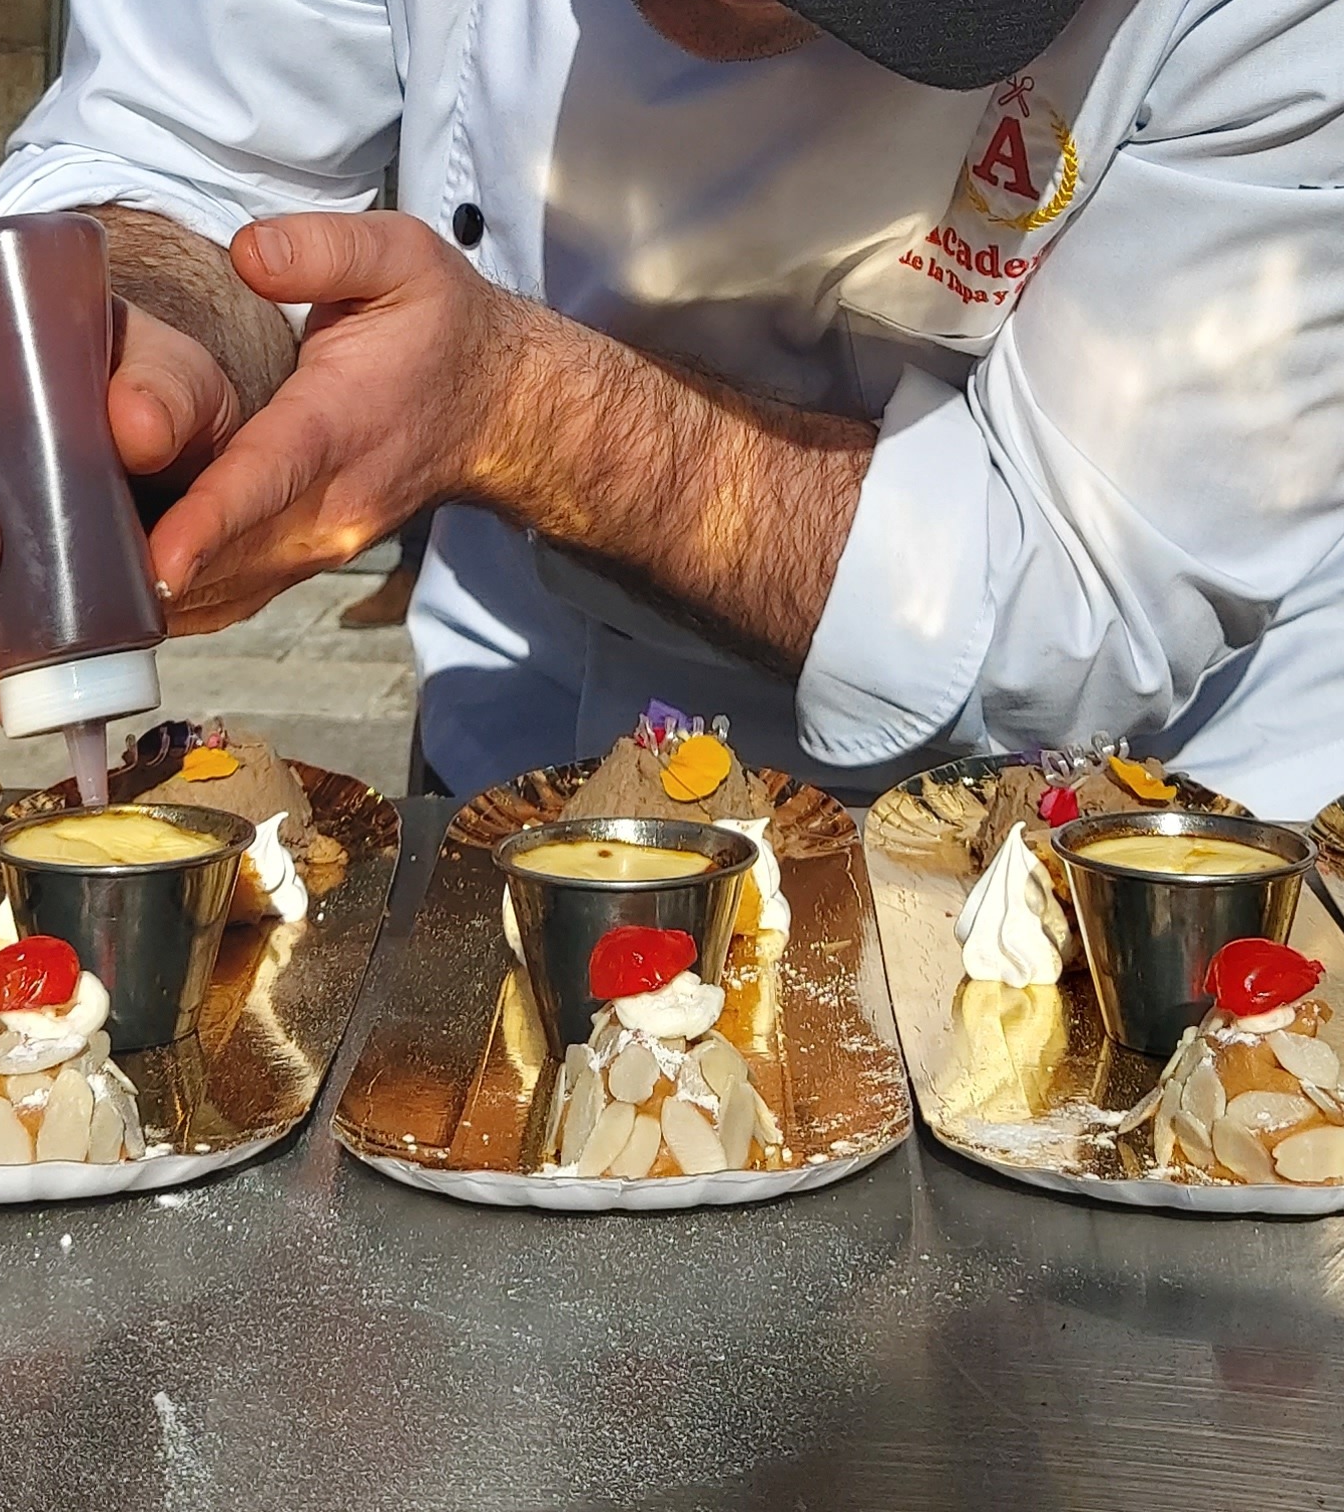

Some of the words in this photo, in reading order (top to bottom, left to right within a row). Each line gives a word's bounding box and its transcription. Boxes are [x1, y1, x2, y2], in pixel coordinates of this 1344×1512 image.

[972, 116, 1041, 202] A
[925, 225, 1042, 278] cade
[994, 289, 1009, 305] y
